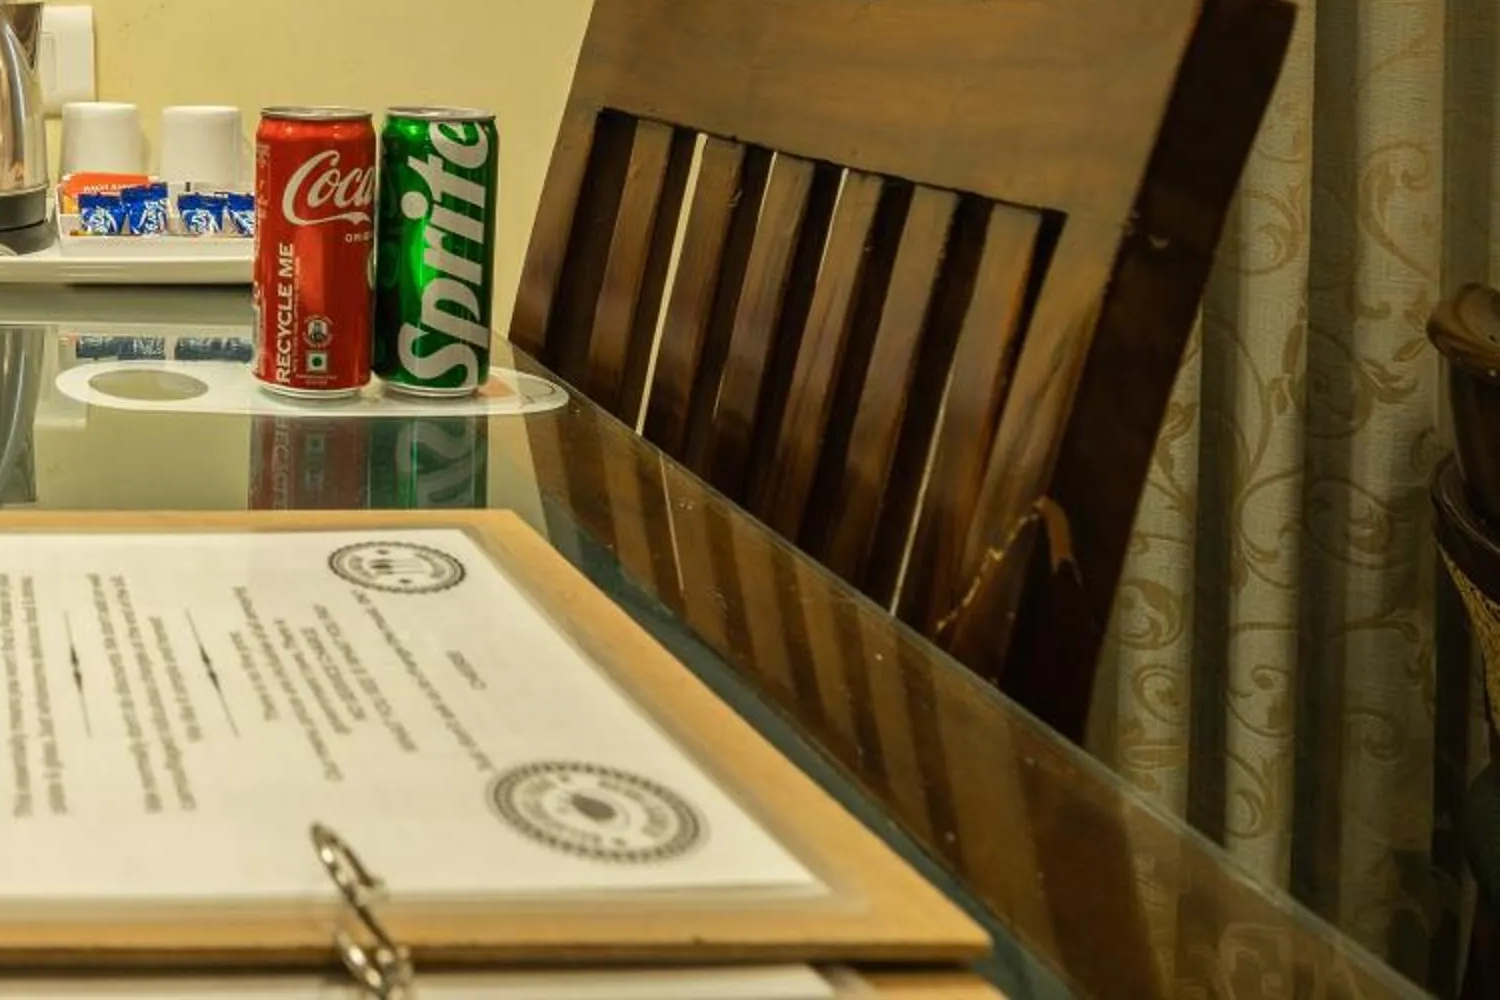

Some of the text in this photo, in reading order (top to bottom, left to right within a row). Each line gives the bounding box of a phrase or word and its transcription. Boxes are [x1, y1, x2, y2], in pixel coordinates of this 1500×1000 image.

[275, 243, 294, 384] RECYCLE ME
[398, 121, 490, 389] Sprite
